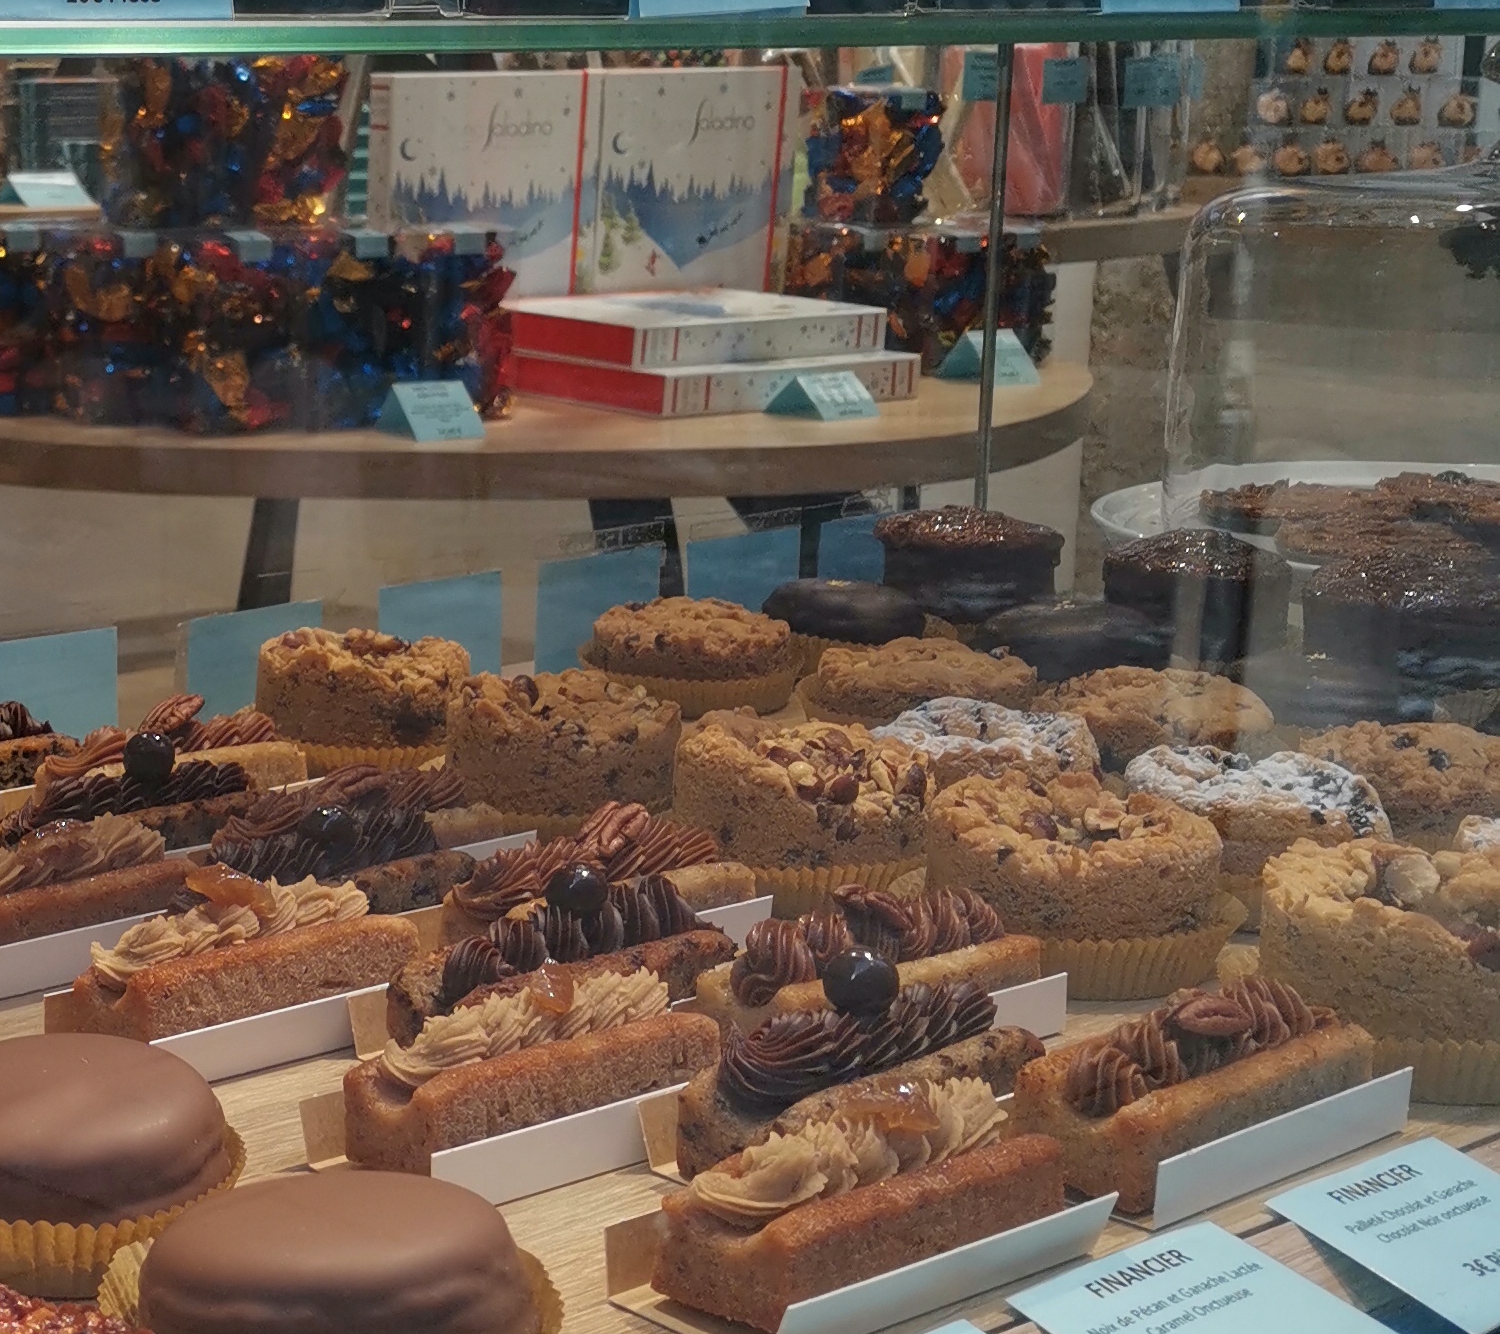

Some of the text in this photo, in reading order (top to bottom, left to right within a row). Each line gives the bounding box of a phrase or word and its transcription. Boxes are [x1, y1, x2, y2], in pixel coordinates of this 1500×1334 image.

[1327, 1164, 1424, 1205] FINANCIER
[1084, 1249, 1194, 1299] FINANCIER
[1117, 1316, 1137, 1328] de
[1130, 1299, 1171, 1320] Pécan
[1167, 1292, 1186, 1305] et
[1178, 1274, 1229, 1299] Ganache
[1192, 1288, 1254, 1317] Onctueuse
